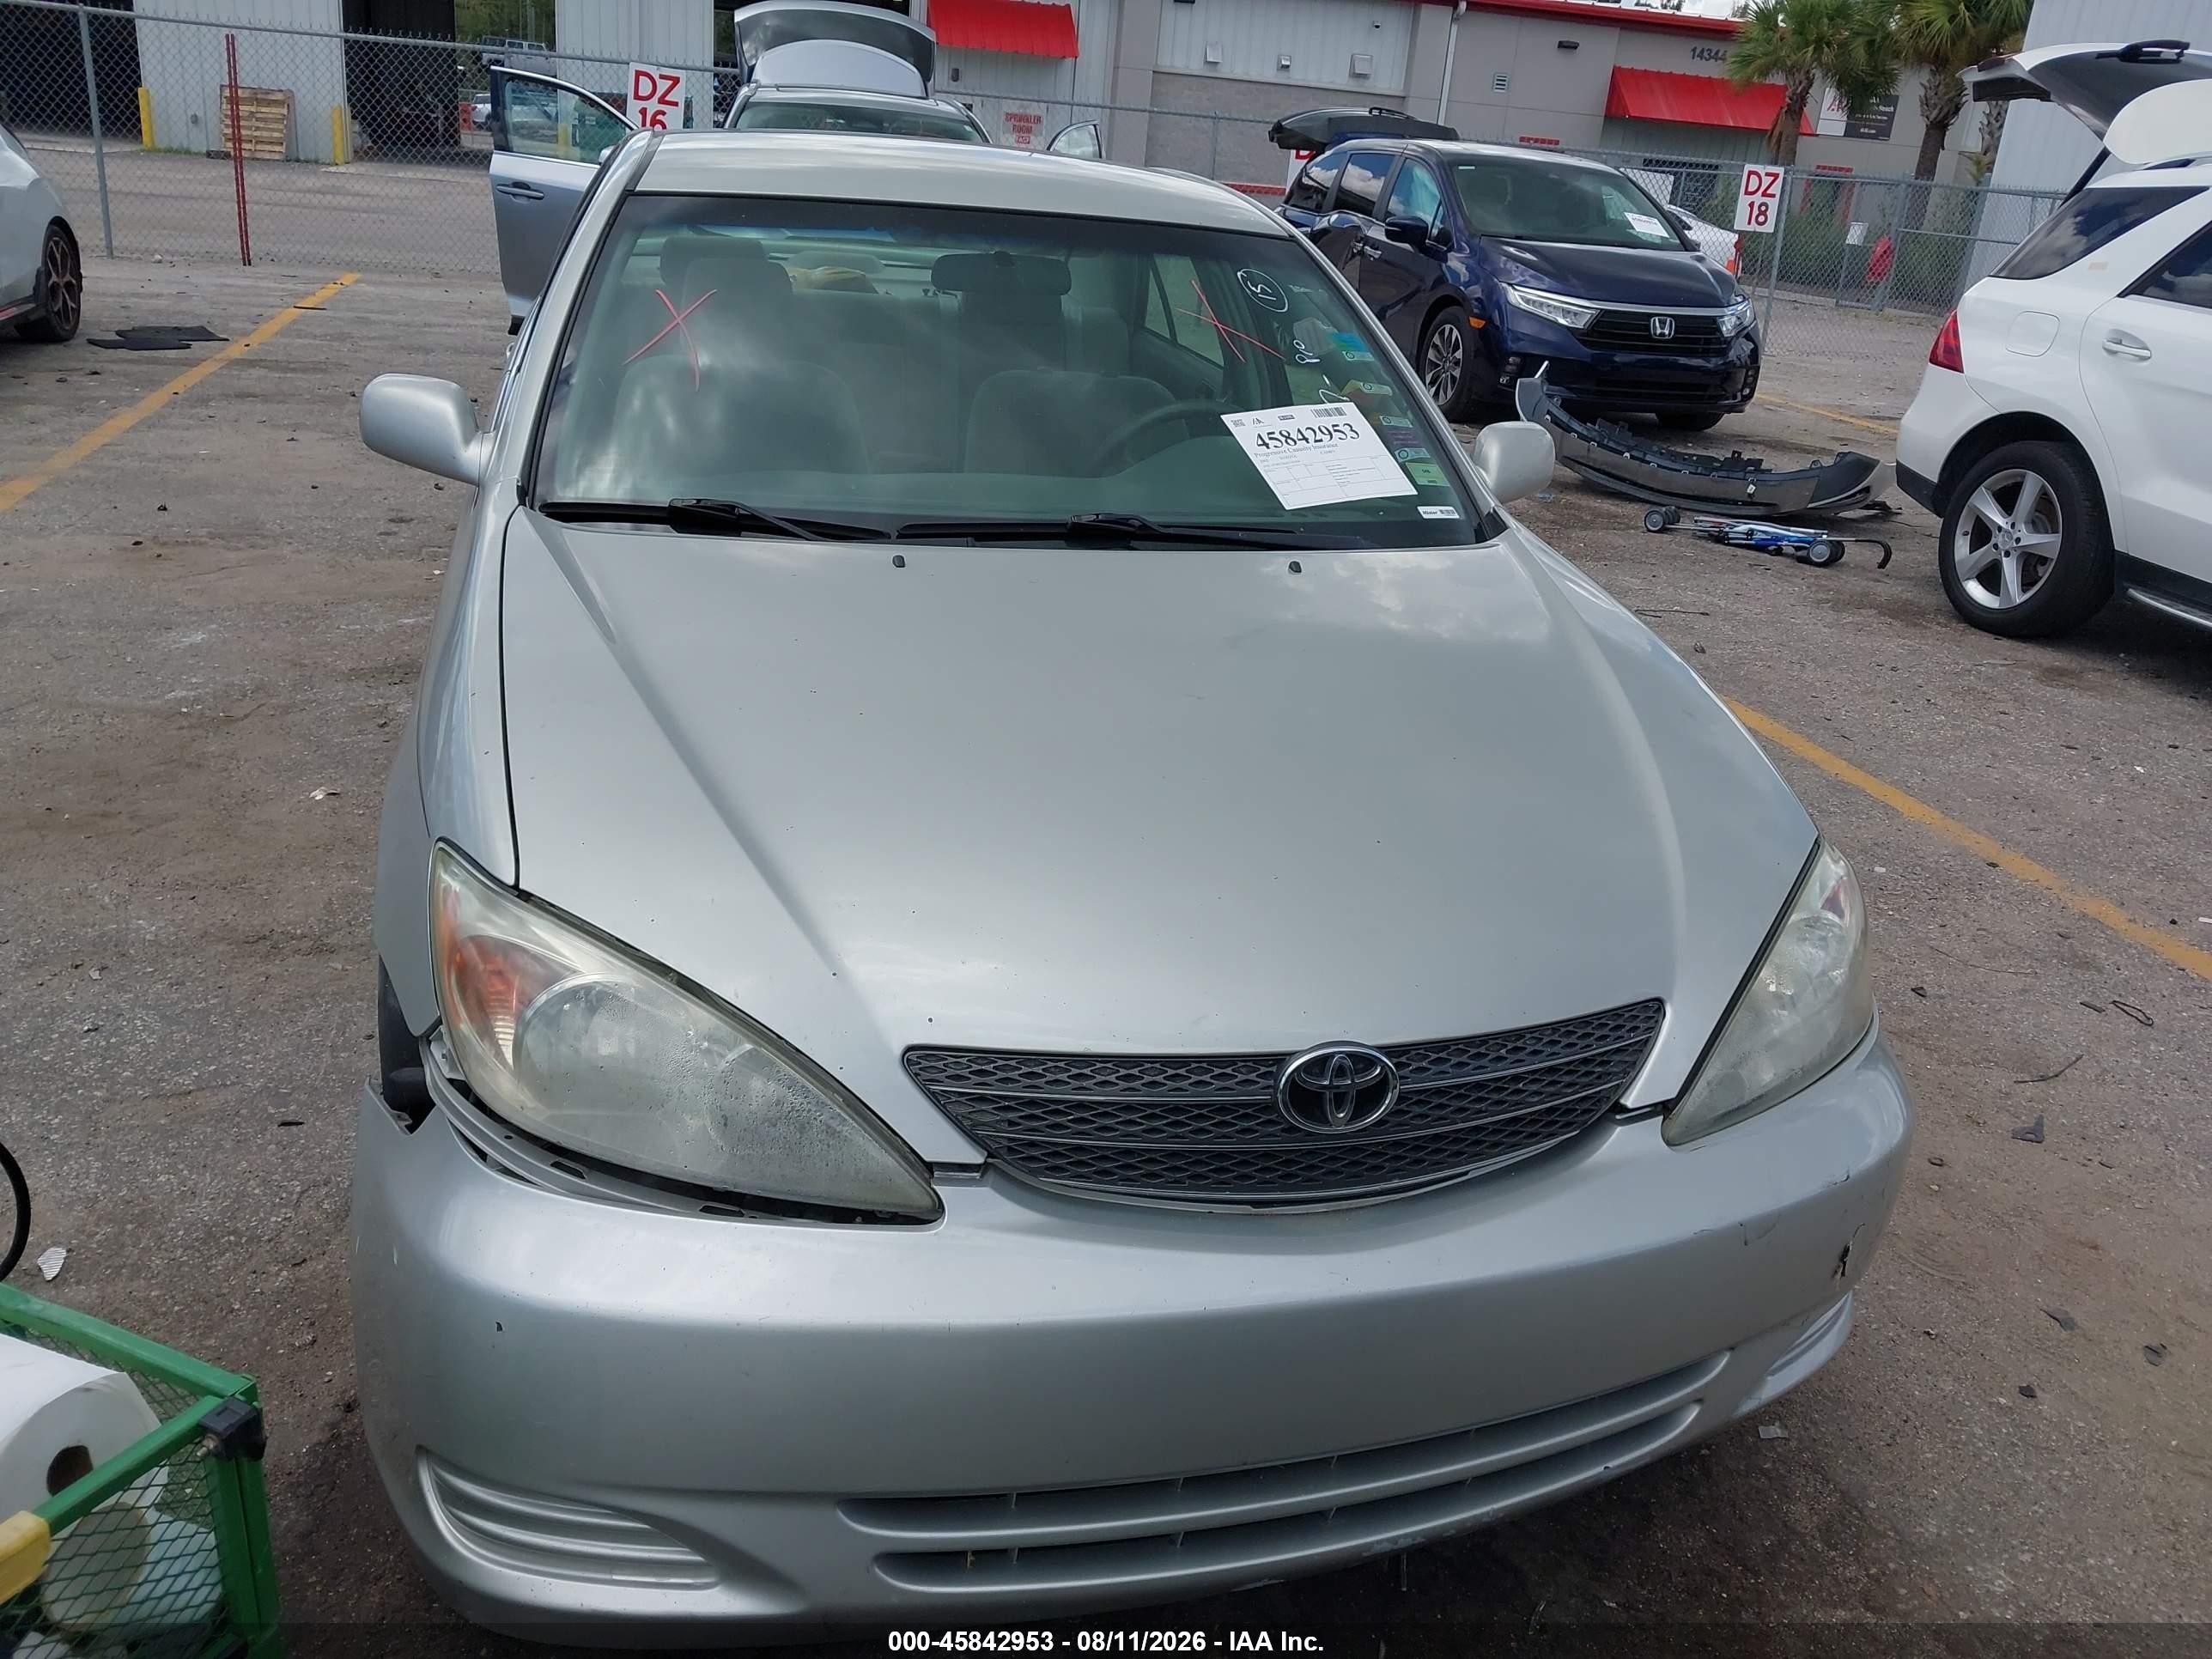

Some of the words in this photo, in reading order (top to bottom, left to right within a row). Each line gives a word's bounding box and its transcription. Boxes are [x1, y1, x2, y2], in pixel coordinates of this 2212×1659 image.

[633, 70, 681, 107] DZ
[638, 106, 667, 130] 16
[1744, 170, 1780, 198] DZ
[1747, 200, 1769, 226] 18
[1255, 422, 1360, 450] 45842953
